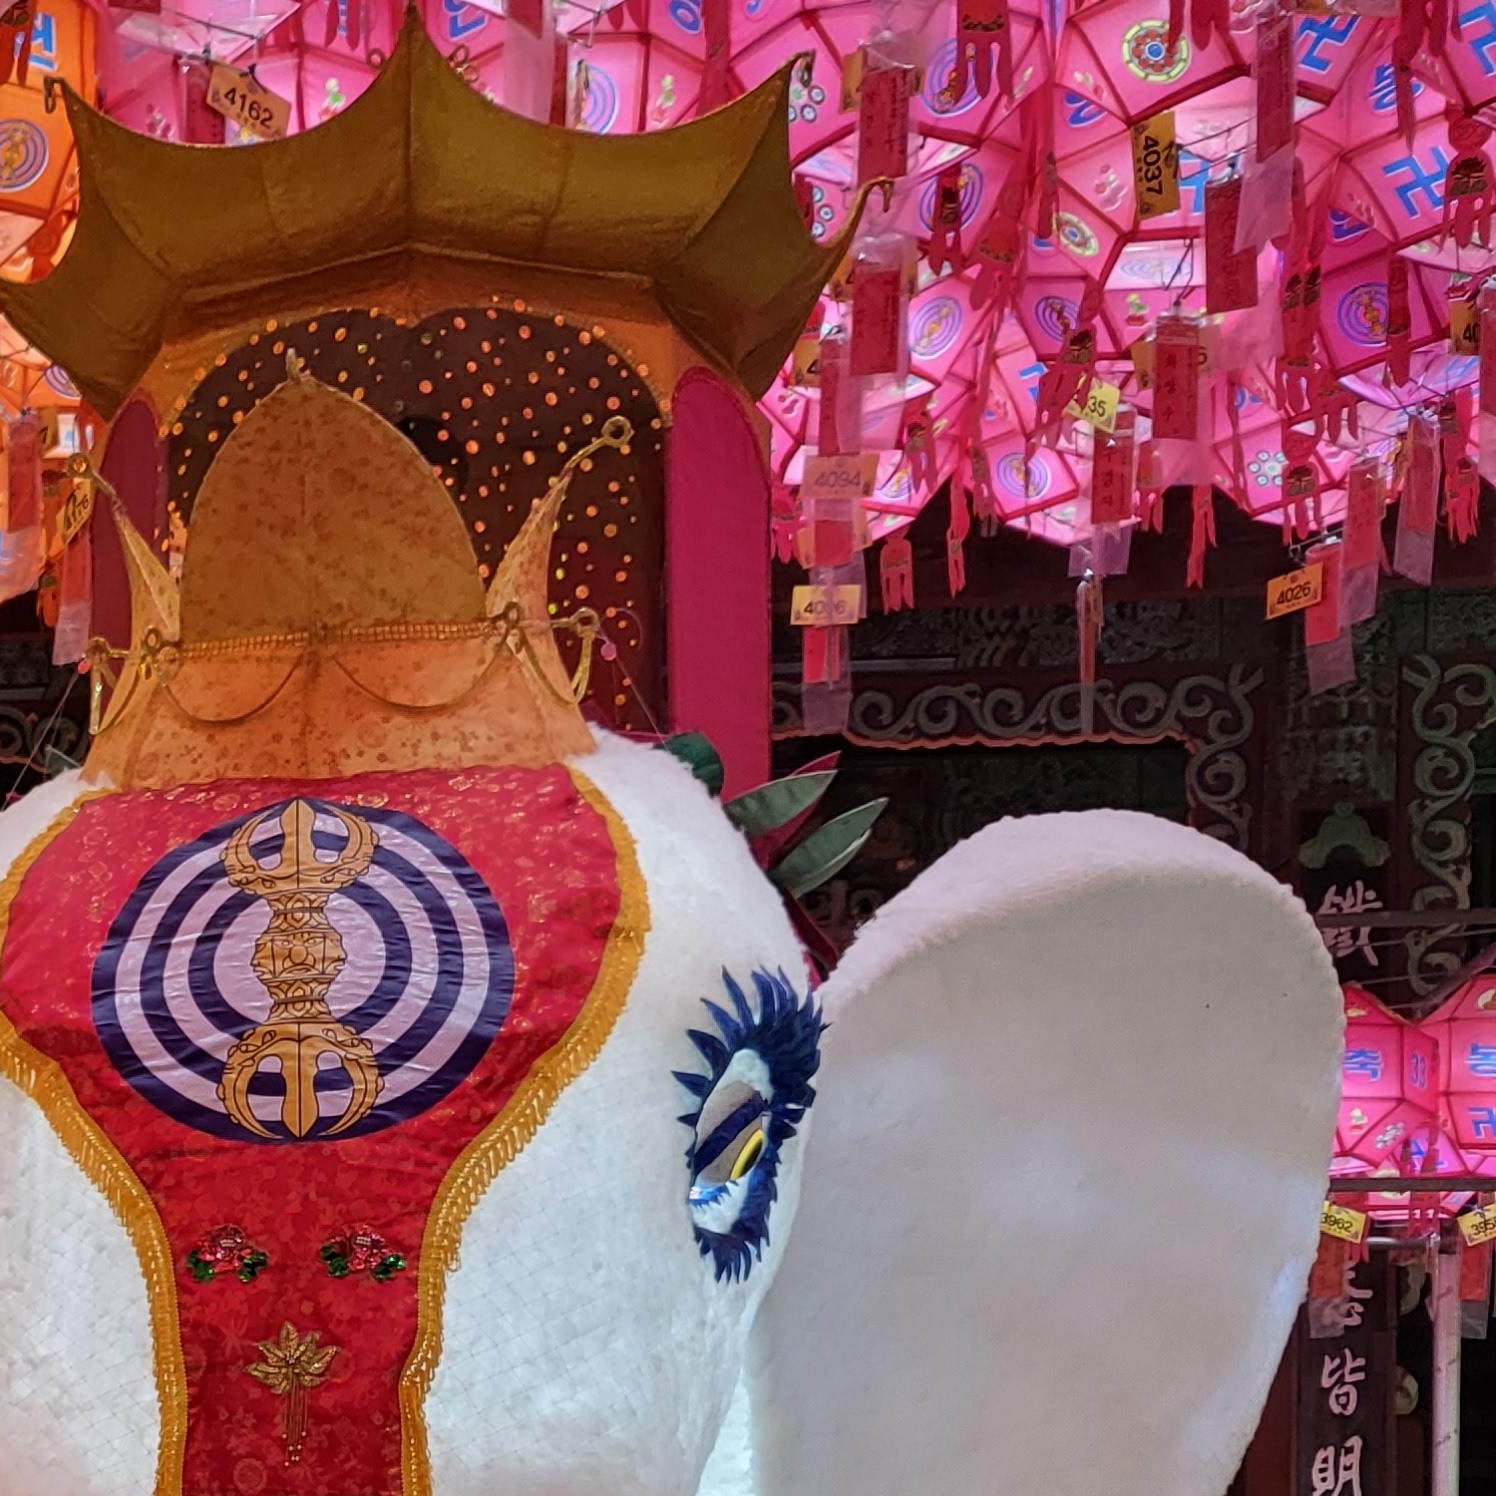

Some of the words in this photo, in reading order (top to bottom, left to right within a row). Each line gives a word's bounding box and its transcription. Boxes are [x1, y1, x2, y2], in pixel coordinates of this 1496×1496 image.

[222, 87, 272, 130] 4162
[1141, 135, 1160, 195] 4037
[1275, 583, 1310, 605] 4026
[1409, 1051, 1426, 1088] 33
[1320, 1212, 1352, 1233] 3962
